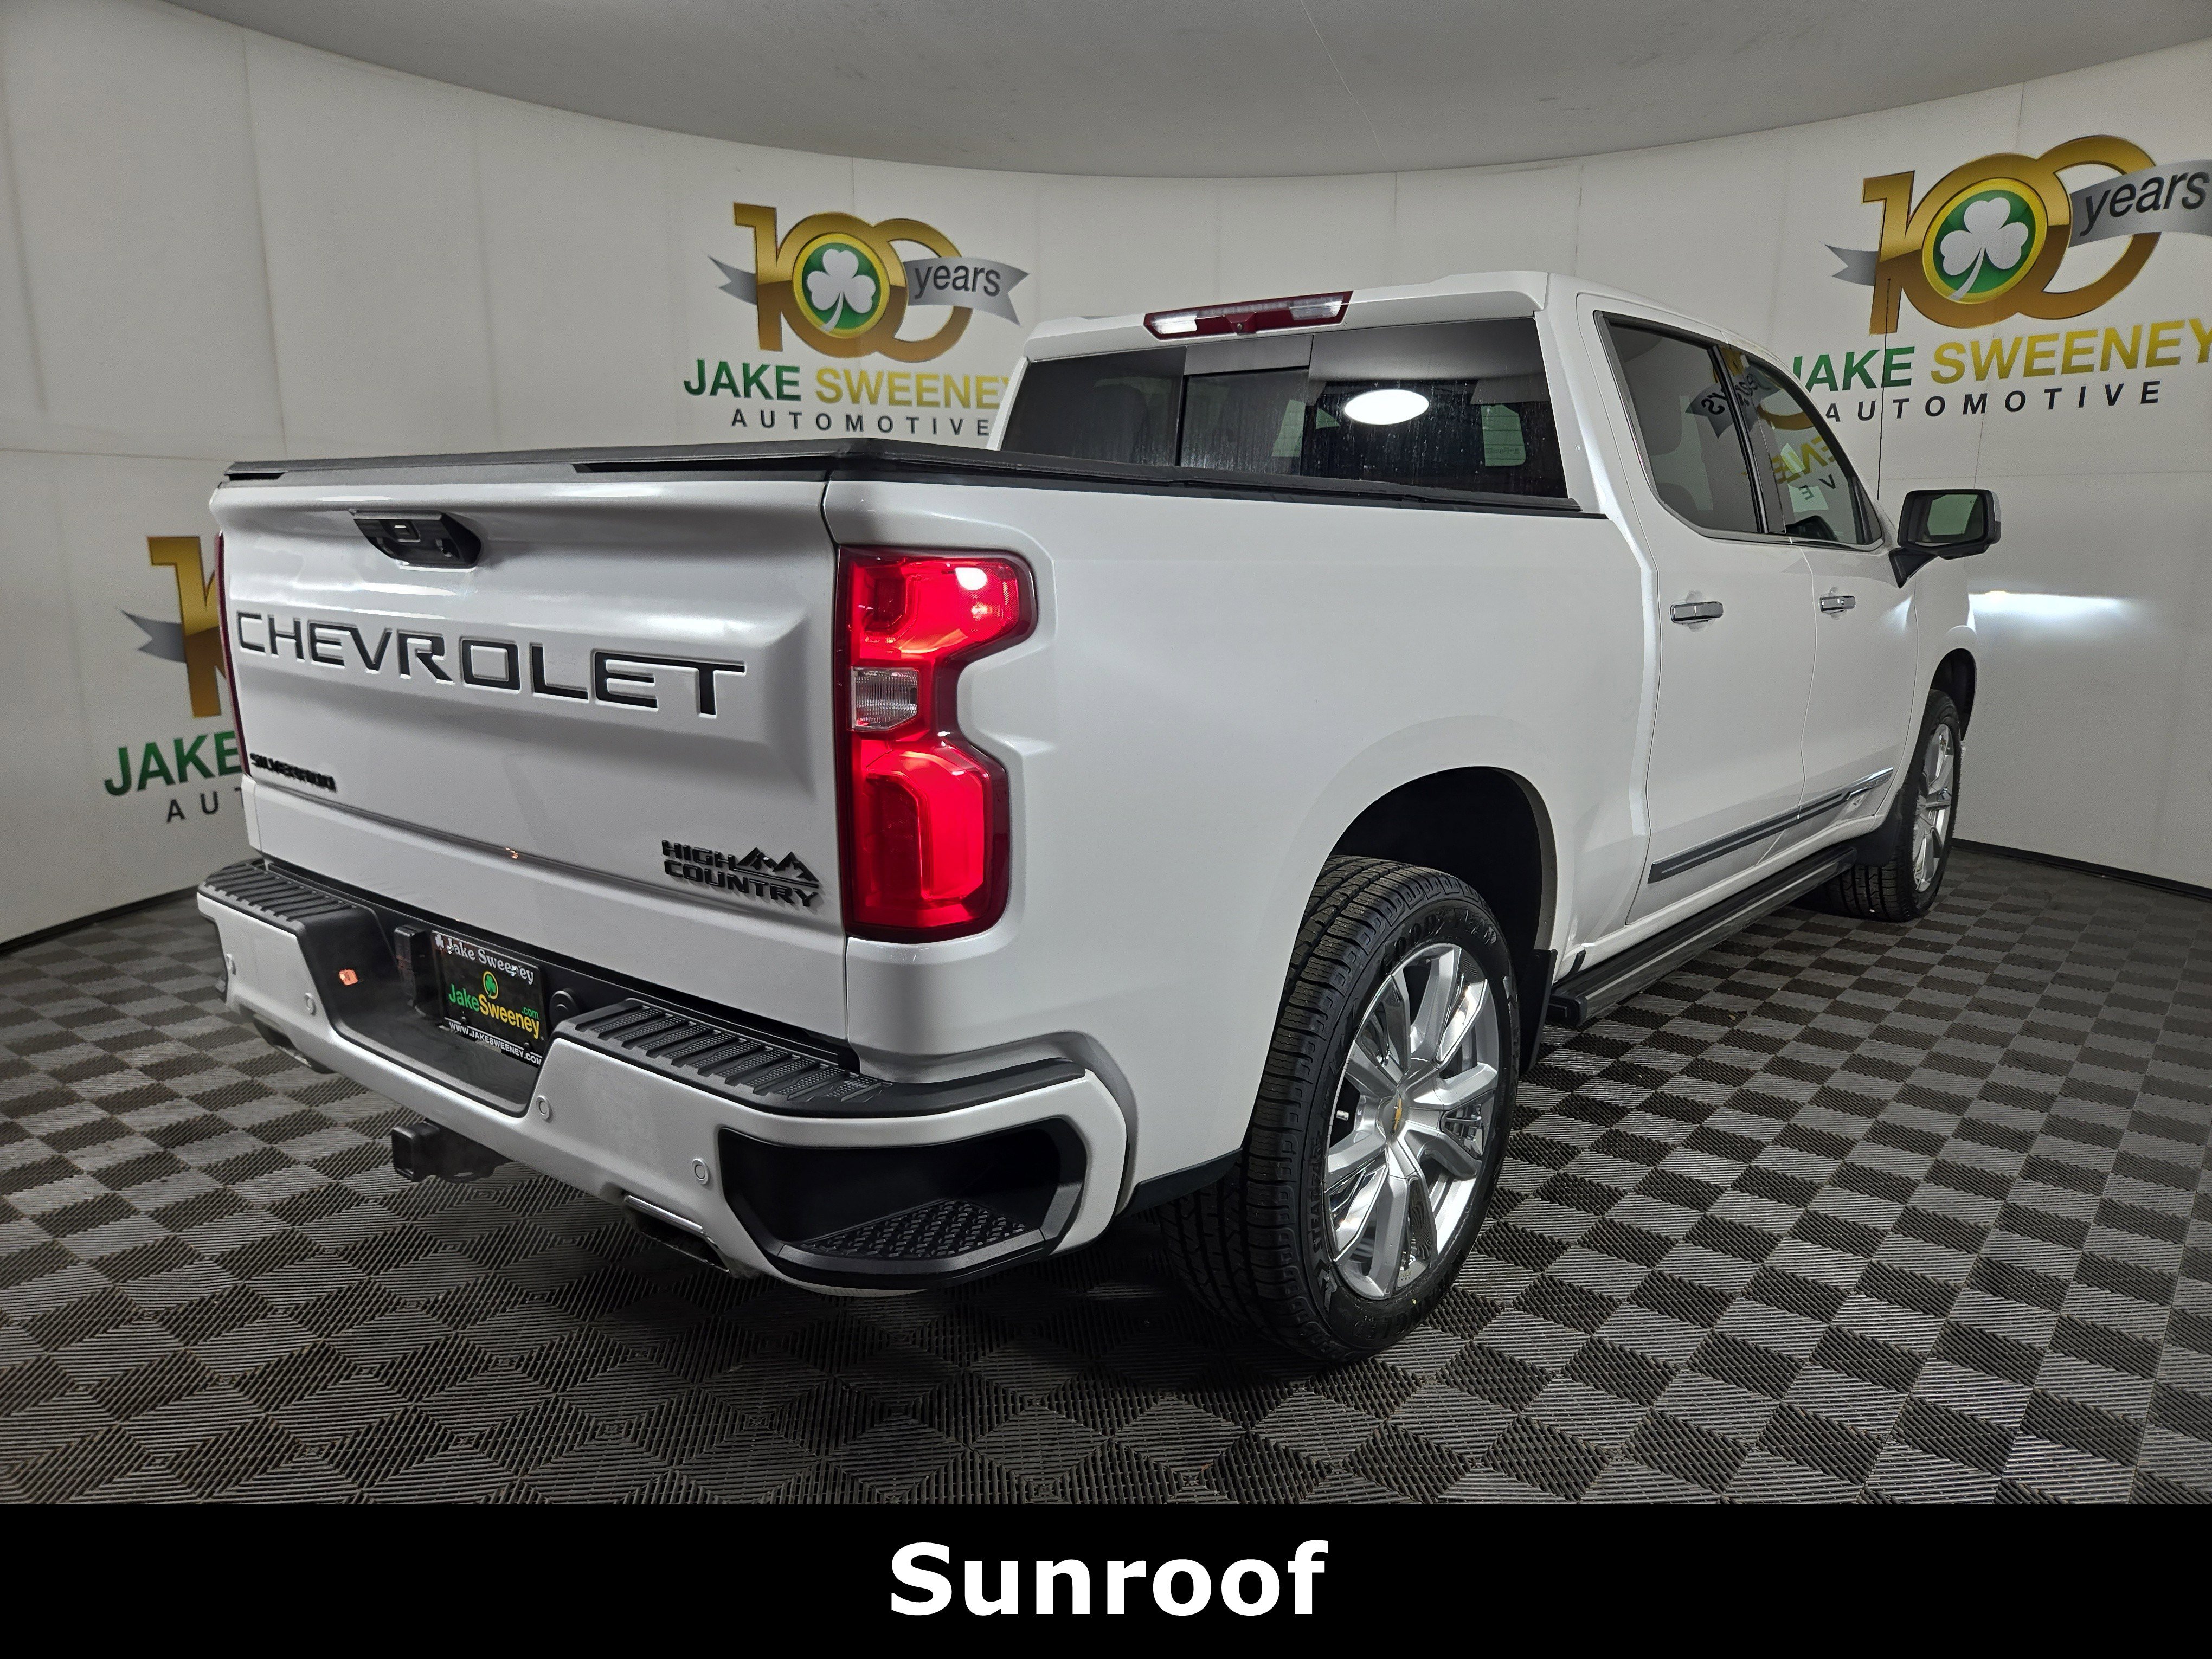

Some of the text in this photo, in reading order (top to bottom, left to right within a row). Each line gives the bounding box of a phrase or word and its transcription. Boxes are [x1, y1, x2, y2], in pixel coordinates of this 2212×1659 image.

[2079, 171, 2210, 237] years
[914, 262, 1001, 299] years
[684, 359, 1009, 409] JAKE SWEENE
[1825, 381, 2161, 422] AUTOMOTIVE
[731, 409, 990, 436] AUTOMOTIVE
[236, 610, 747, 718] CHEVROLET
[104, 731, 243, 796] JAKE
[661, 839, 736, 871] HIGH
[664, 859, 820, 908] COUNTRY
[447, 937, 534, 985] Jake Sweeney
